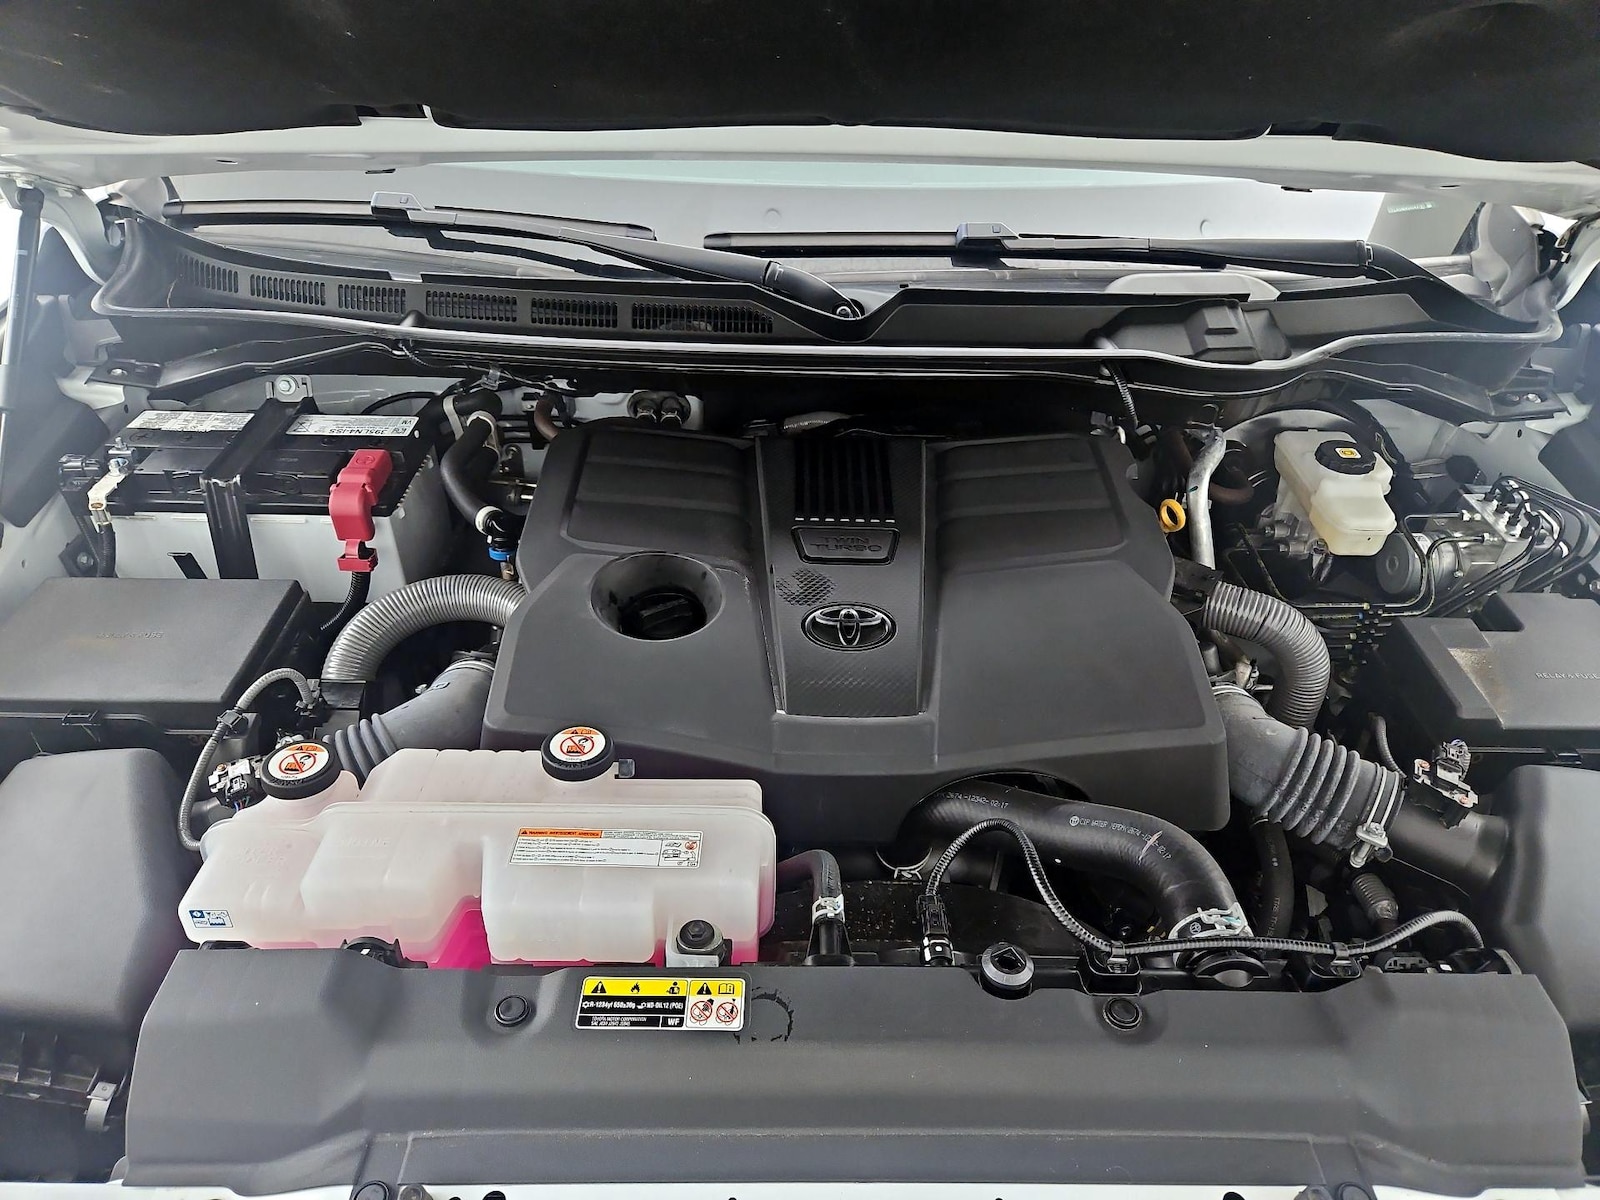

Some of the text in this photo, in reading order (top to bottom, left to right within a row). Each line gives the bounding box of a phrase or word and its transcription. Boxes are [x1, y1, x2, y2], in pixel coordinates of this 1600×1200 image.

[821, 535, 870, 544] TWIN
[809, 543, 883, 552] TURBO
[667, 1018, 680, 1026] WF
